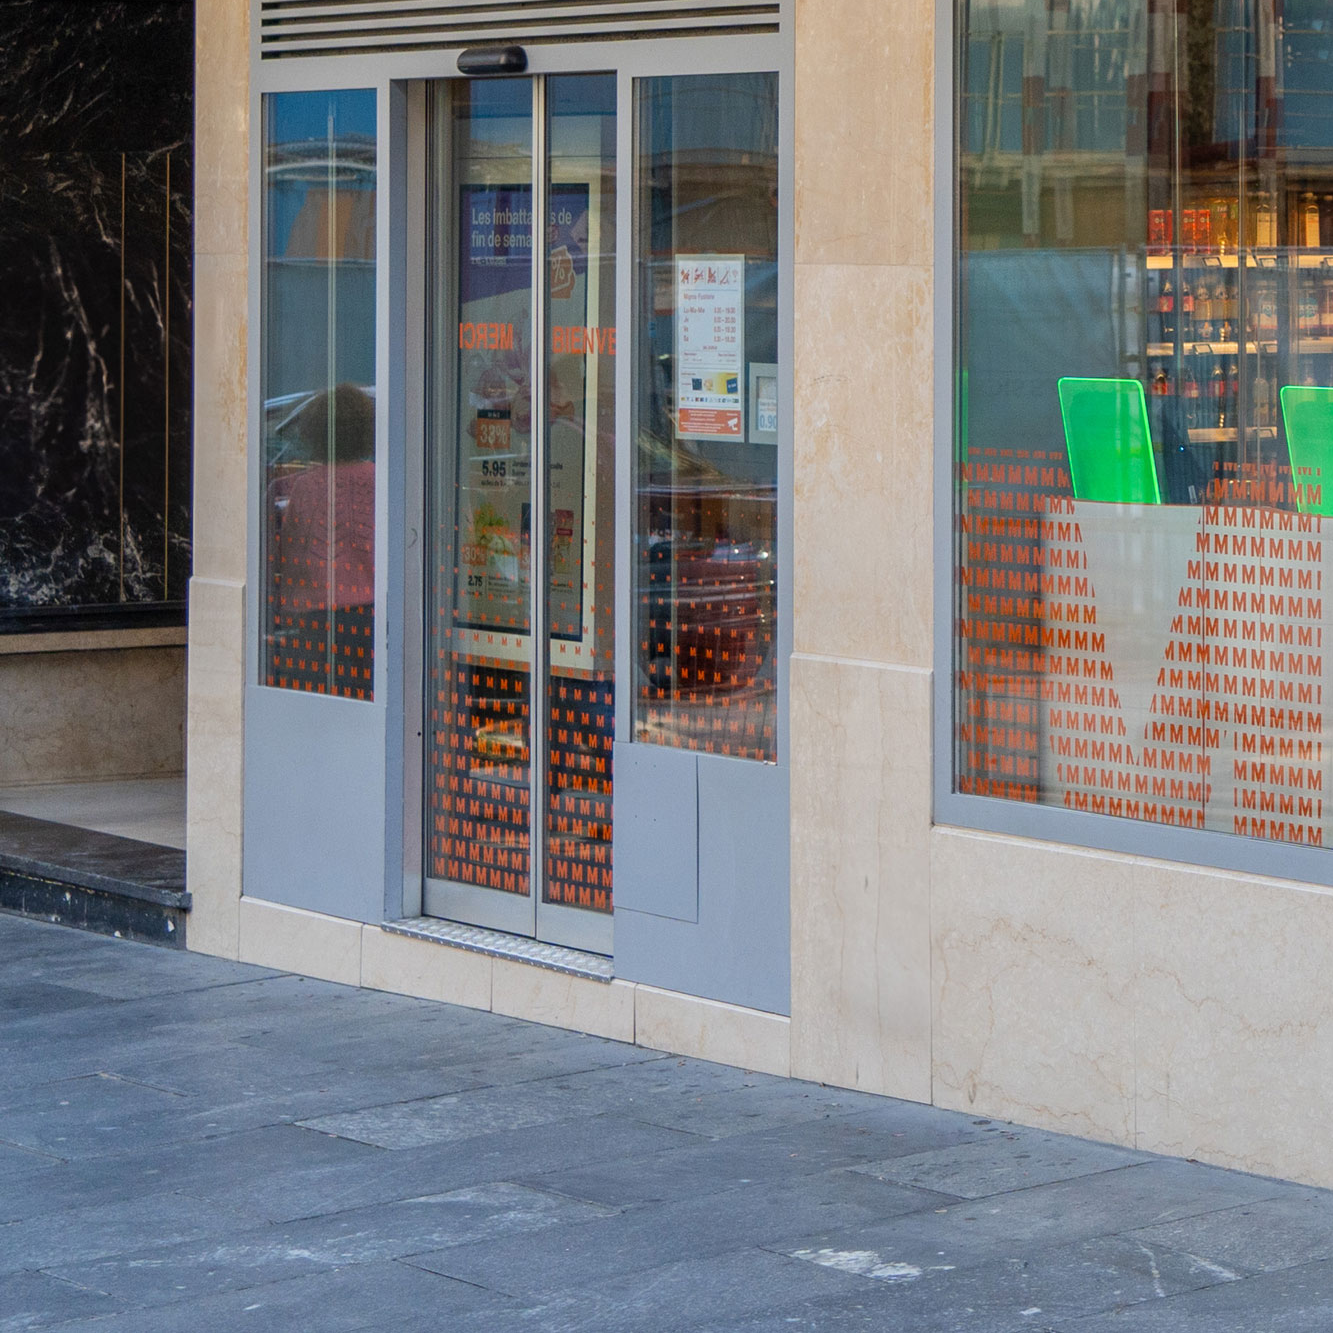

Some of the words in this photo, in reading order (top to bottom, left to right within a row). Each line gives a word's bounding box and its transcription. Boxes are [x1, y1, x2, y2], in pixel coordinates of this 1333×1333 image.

[472, 208, 490, 225] Les
[559, 208, 572, 225] de
[472, 232, 486, 247] fin
[489, 232, 501, 247] de
[482, 460, 507, 478] 5.95
